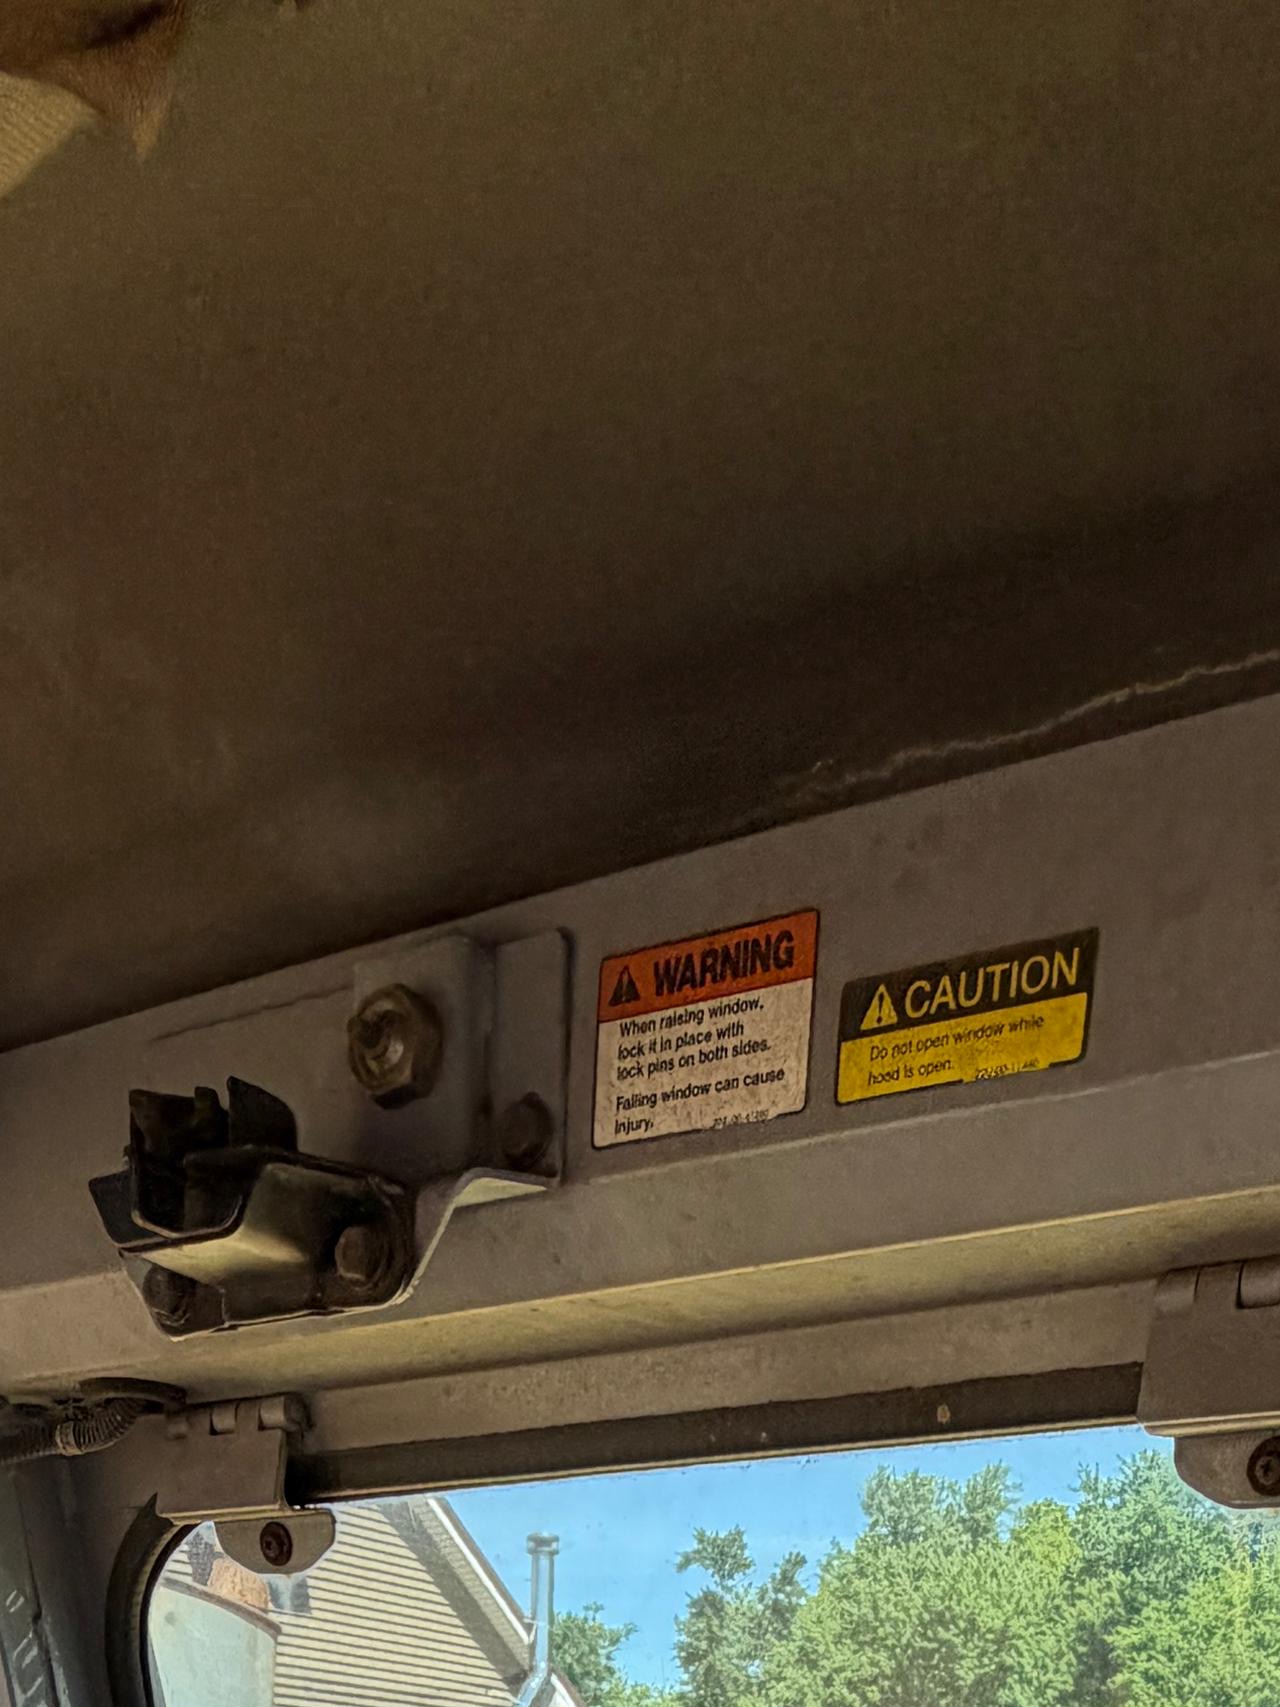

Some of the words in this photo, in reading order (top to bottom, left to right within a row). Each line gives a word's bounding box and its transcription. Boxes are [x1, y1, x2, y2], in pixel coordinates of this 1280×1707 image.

[653, 930, 795, 996] WARNING
[904, 946, 1080, 1018] CAUTION
[618, 1038, 644, 1060] lock
[649, 1038, 657, 1053] it
[661, 1036, 672, 1052] in
[675, 1029, 712, 1052] place
[716, 1019, 744, 1040] with
[620, 1019, 656, 1037] When
[660, 1008, 704, 1029] raising
[870, 1044, 888, 1062] Do
[891, 1041, 913, 1058] not
[916, 1034, 950, 1056] open
[952, 1025, 1004, 1045] window
[1008, 1013, 1045, 1032] while
[617, 1060, 644, 1080] lock
[647, 1057, 675, 1079] pins
[678, 1051, 695, 1068] on
[698, 1044, 728, 1064] both
[732, 1037, 771, 1057] sides.
[867, 1068, 900, 1086] hood
[904, 1065, 915, 1080] is
[616, 1092, 657, 1112] Falling
[661, 1080, 710, 1102] window
[715, 1075, 739, 1092] can
[743, 1066, 785, 1087] cause
